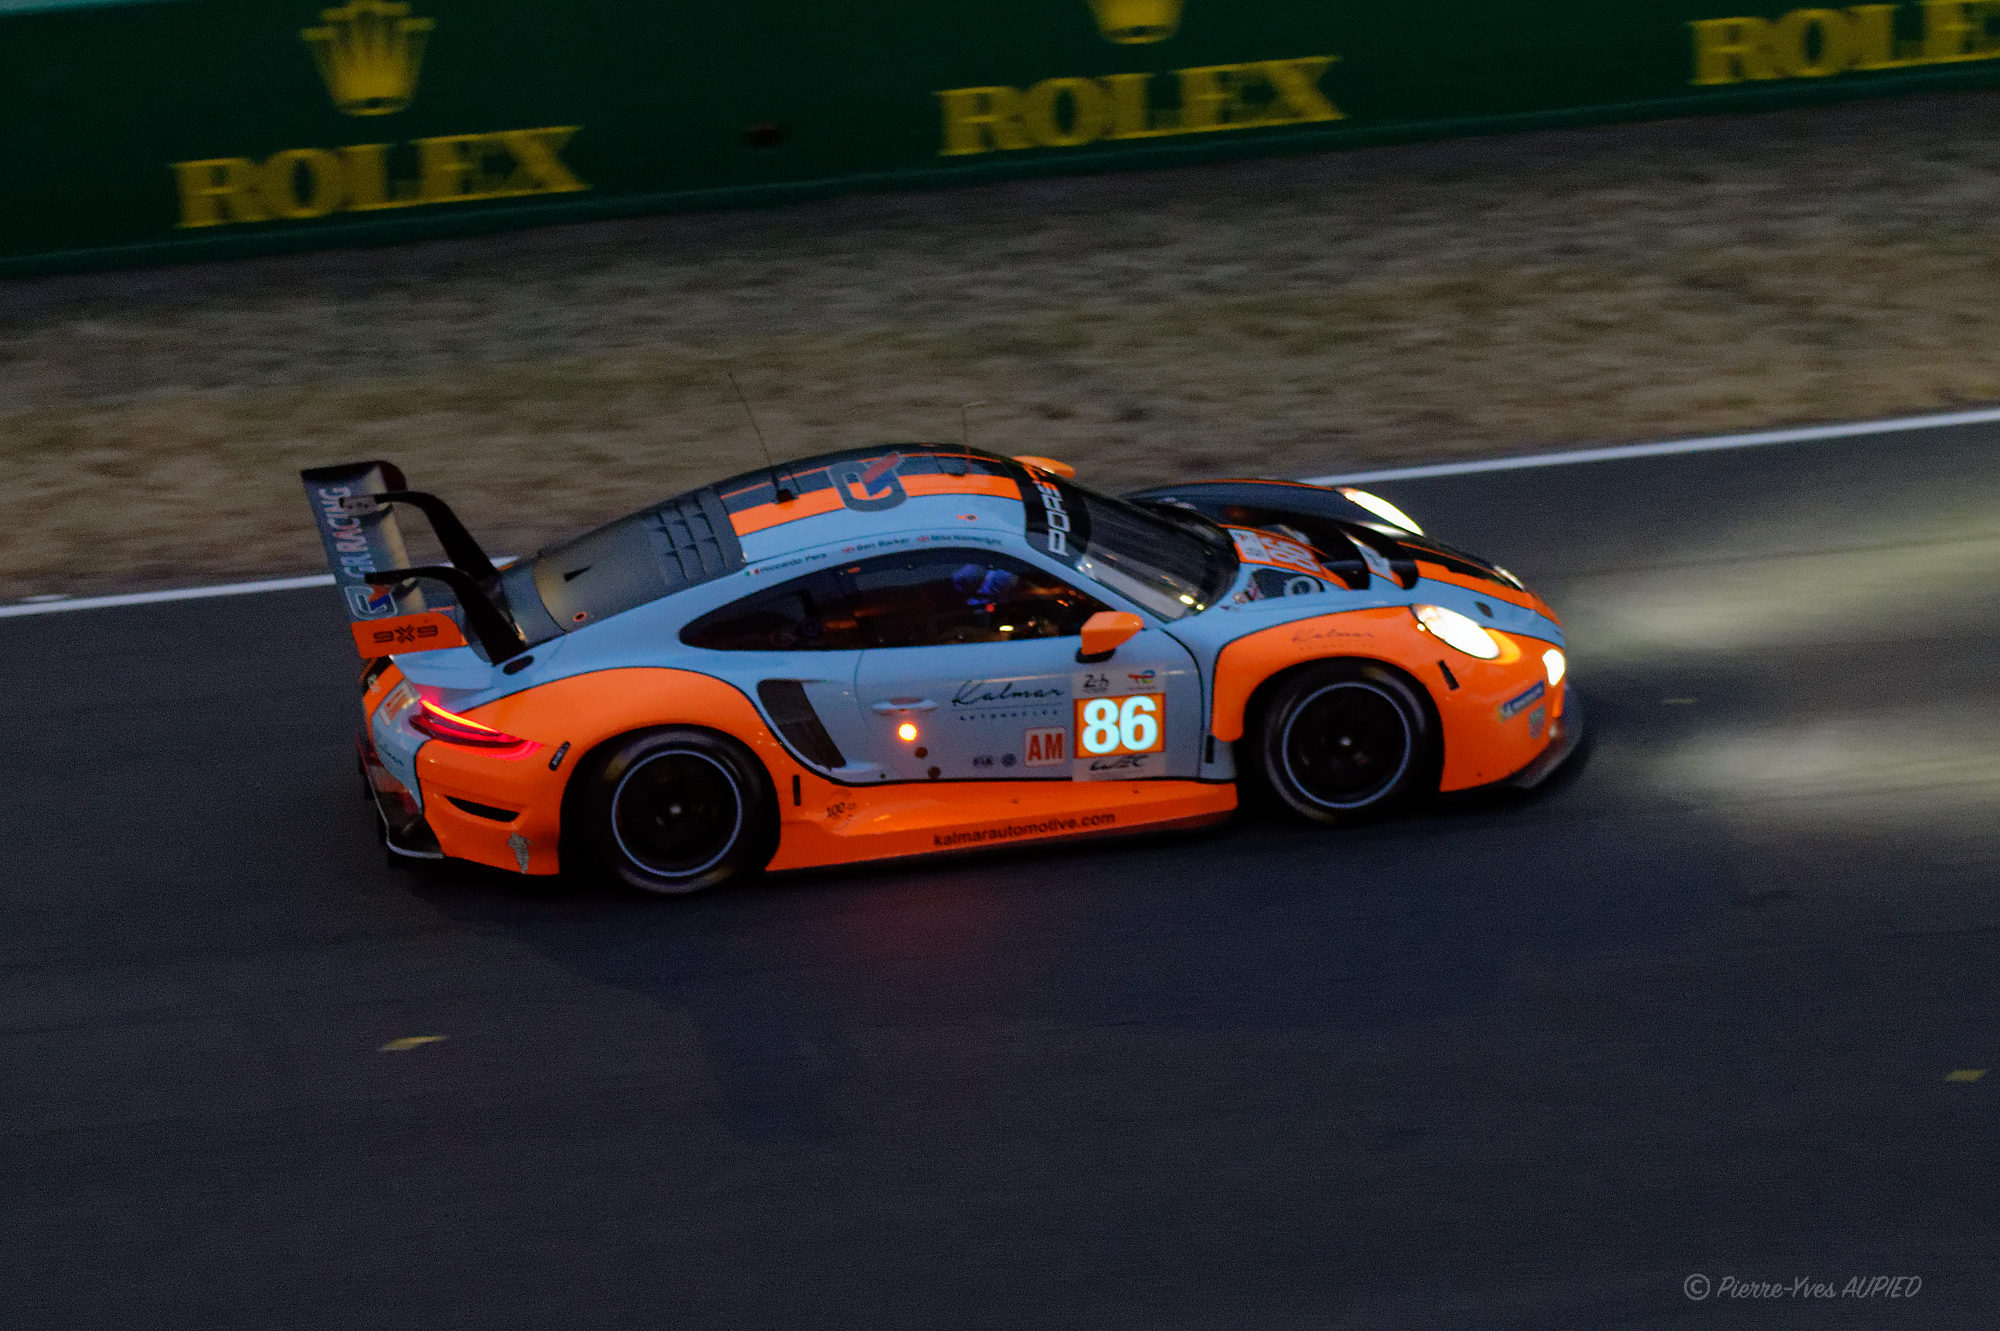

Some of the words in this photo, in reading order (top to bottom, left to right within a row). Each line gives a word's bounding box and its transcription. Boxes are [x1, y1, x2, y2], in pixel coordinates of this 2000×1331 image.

[1685, 0, 2000, 86] ROLE
[936, 55, 1346, 156] ROLEX
[172, 125, 591, 229] ROLEX
[952, 680, 1065, 707] Kalmar
[1027, 732, 1063, 761] AM
[1082, 694, 1159, 754] 86
[933, 813, 1116, 847] kalmarautomotive.com
